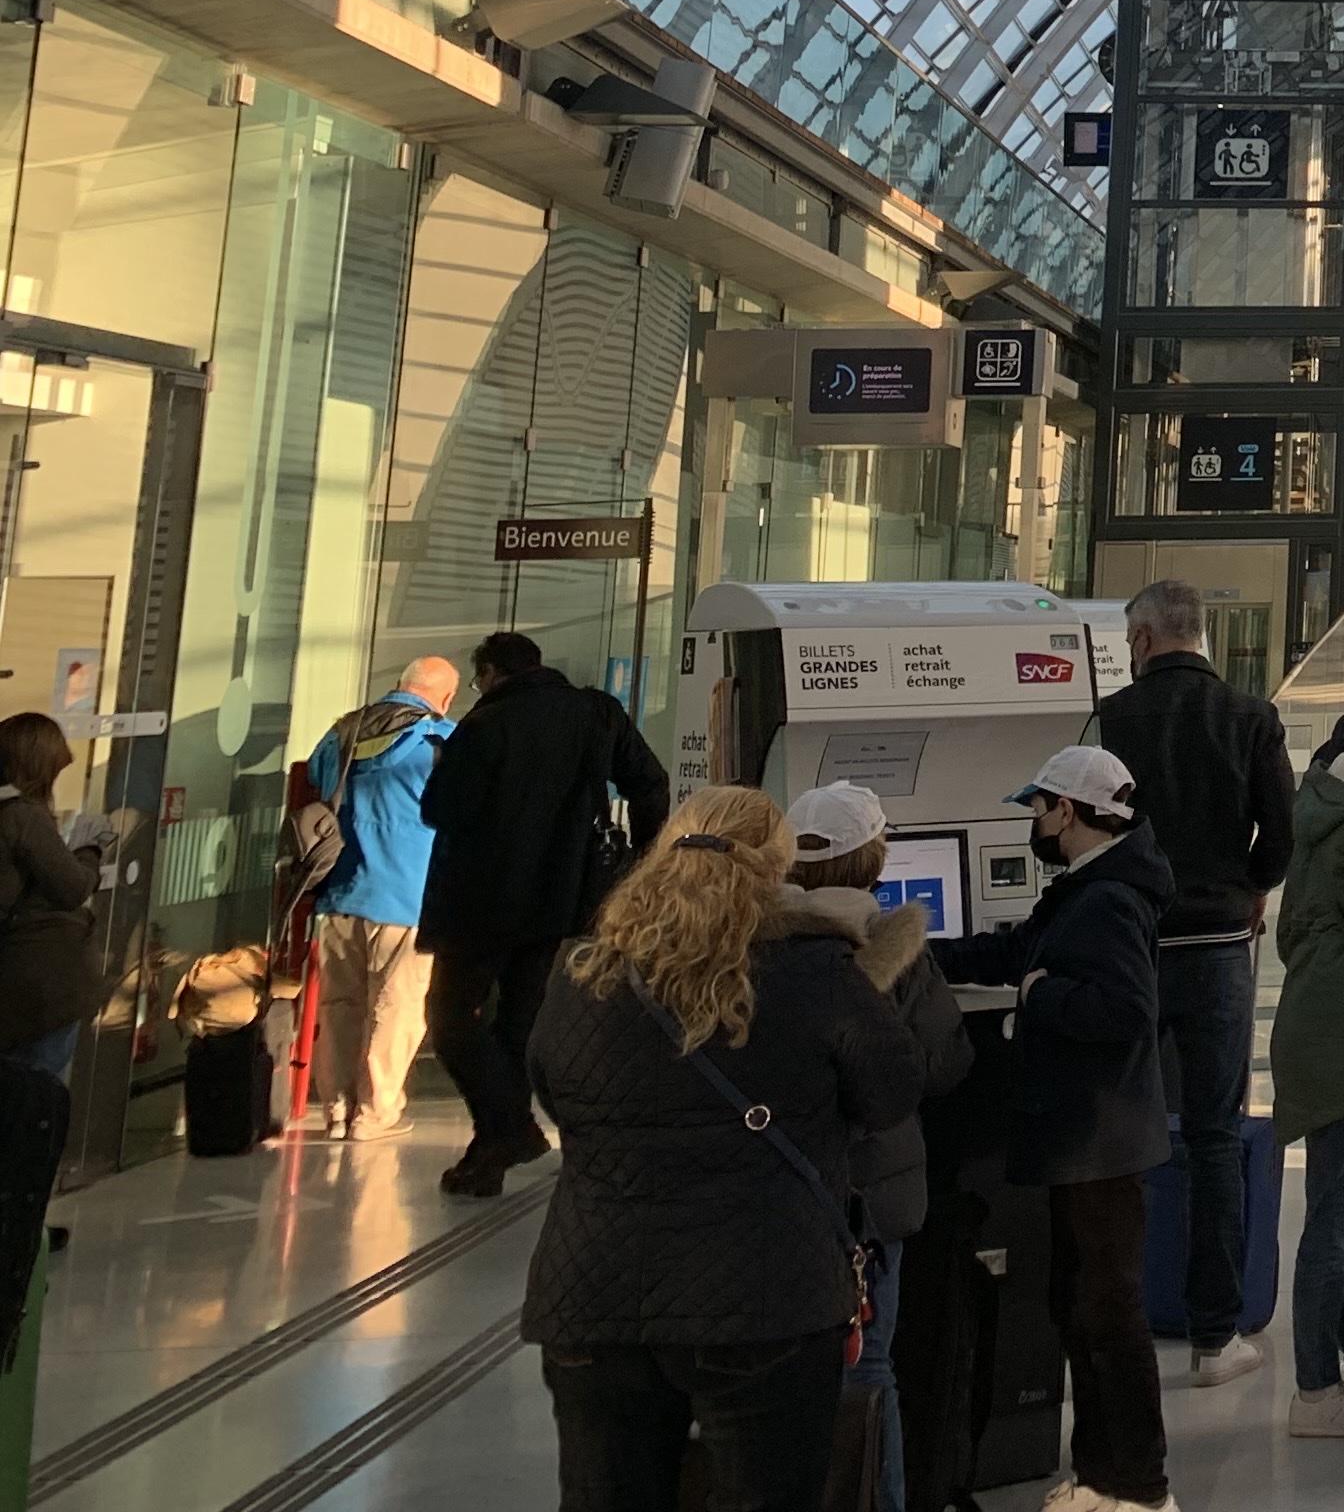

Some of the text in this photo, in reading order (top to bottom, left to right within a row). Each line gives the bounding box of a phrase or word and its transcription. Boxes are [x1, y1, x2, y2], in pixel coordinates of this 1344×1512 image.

[1240, 455, 1256, 476] 4
[504, 527, 629, 549] Bienvenue
[800, 645, 855, 658] BILLETS
[903, 644, 943, 656] achat
[800, 661, 878, 674] GRANDES
[905, 659, 951, 672] retrait
[1020, 664, 1070, 680] SNCF
[802, 677, 859, 690] LIGNES
[906, 675, 966, 689] échange
[681, 730, 707, 752] achat
[679, 758, 708, 779] retrait
